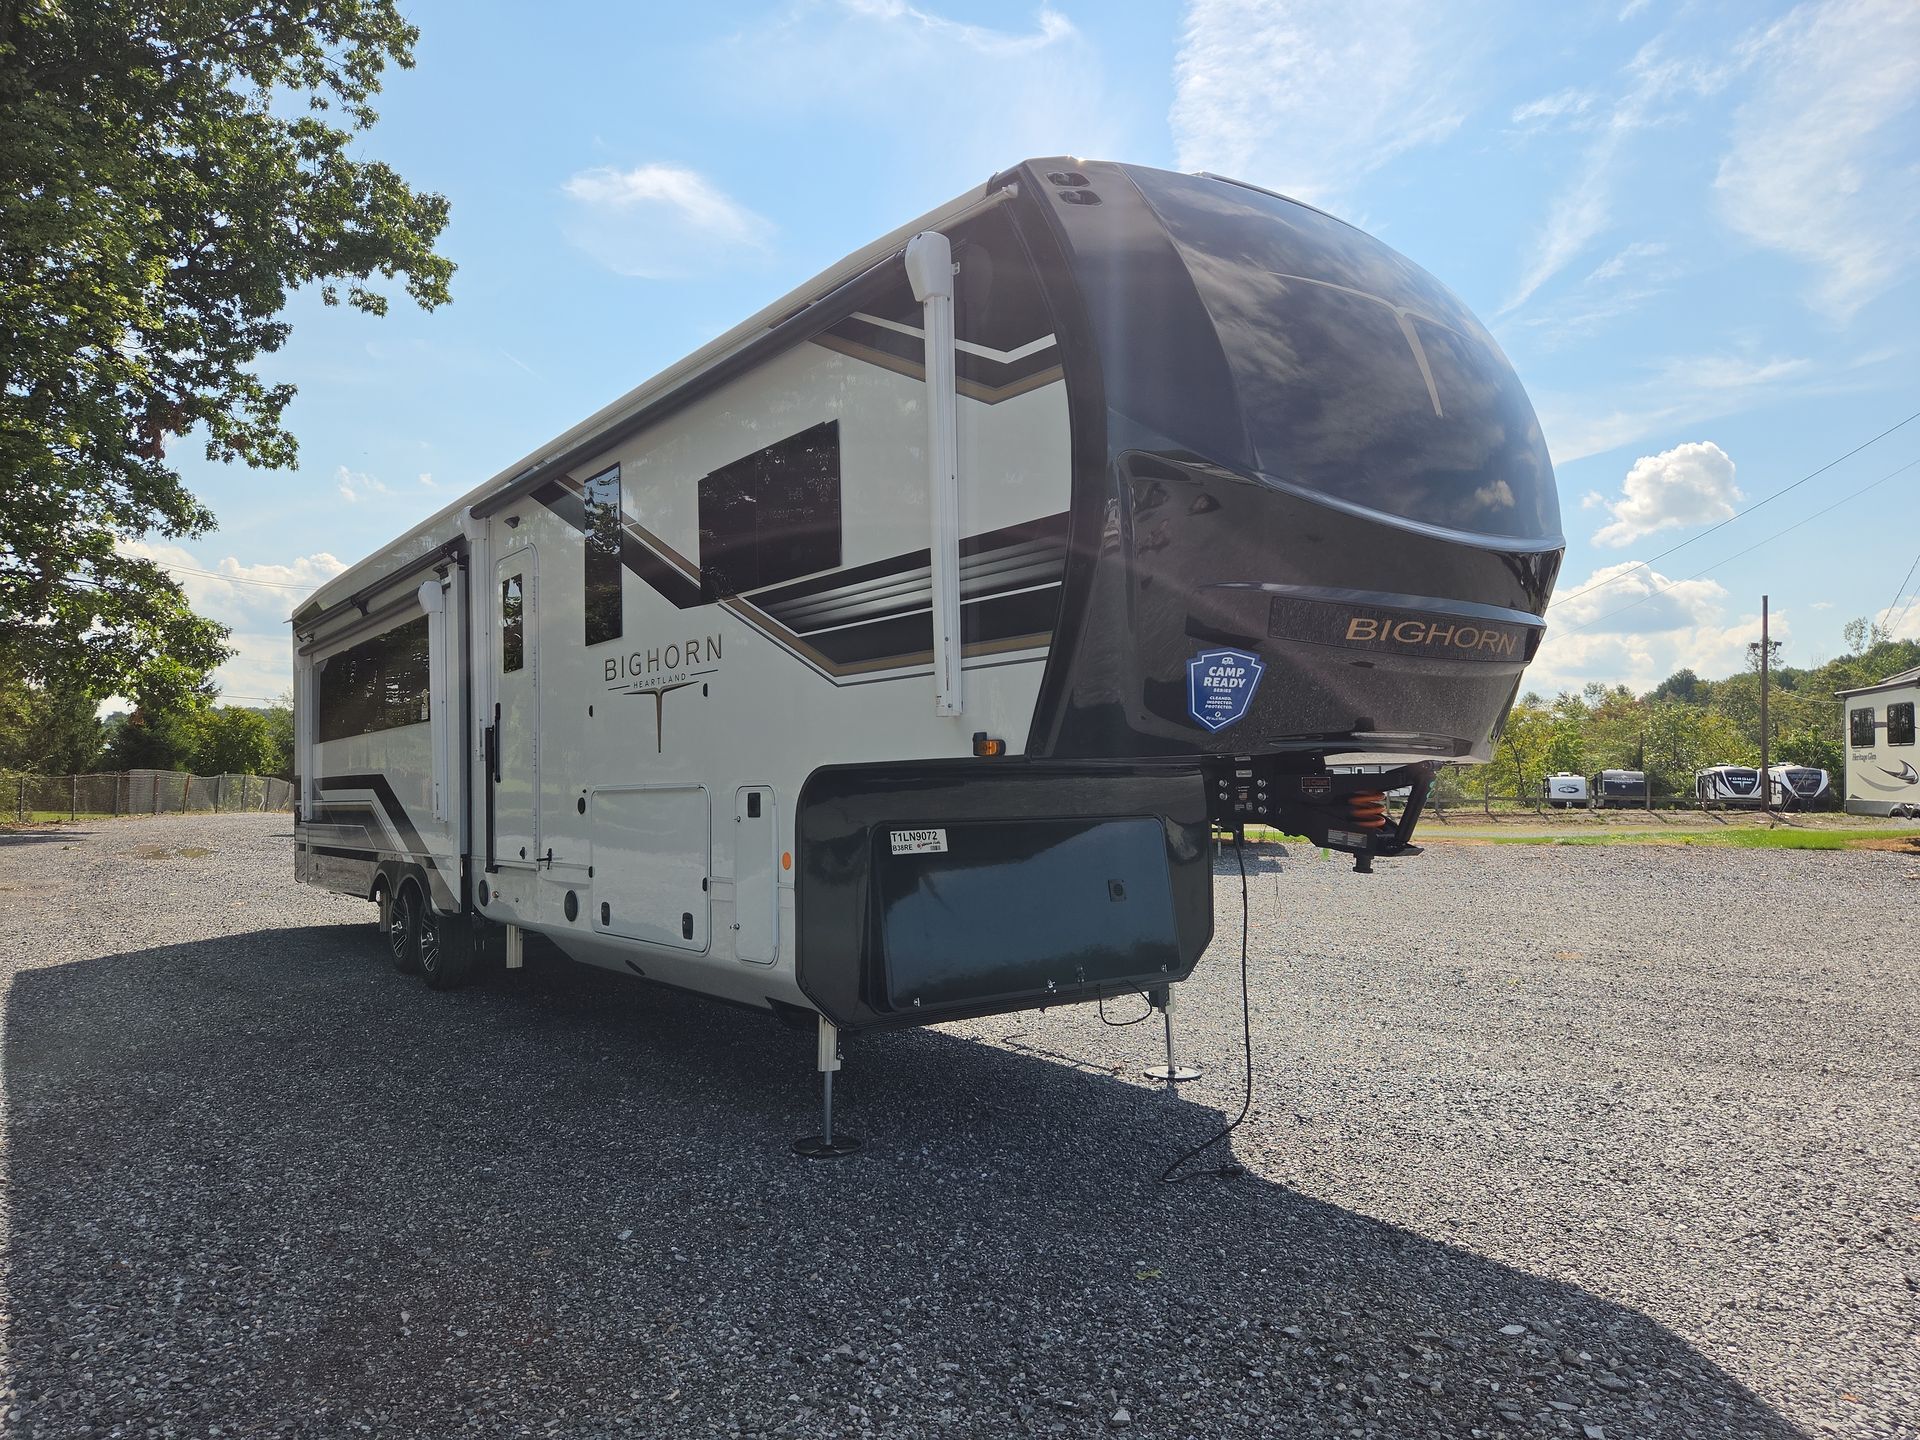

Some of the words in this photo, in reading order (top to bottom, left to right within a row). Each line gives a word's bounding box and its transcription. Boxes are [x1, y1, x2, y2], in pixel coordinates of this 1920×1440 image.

[1345, 617, 1518, 656] BIGHORN
[604, 633, 722, 682] BIGHORN
[1208, 666, 1246, 678] CAMP
[633, 673, 687, 689] HEARTLAND
[1203, 676, 1246, 688] READY
[891, 830, 938, 842] T1LN9072
